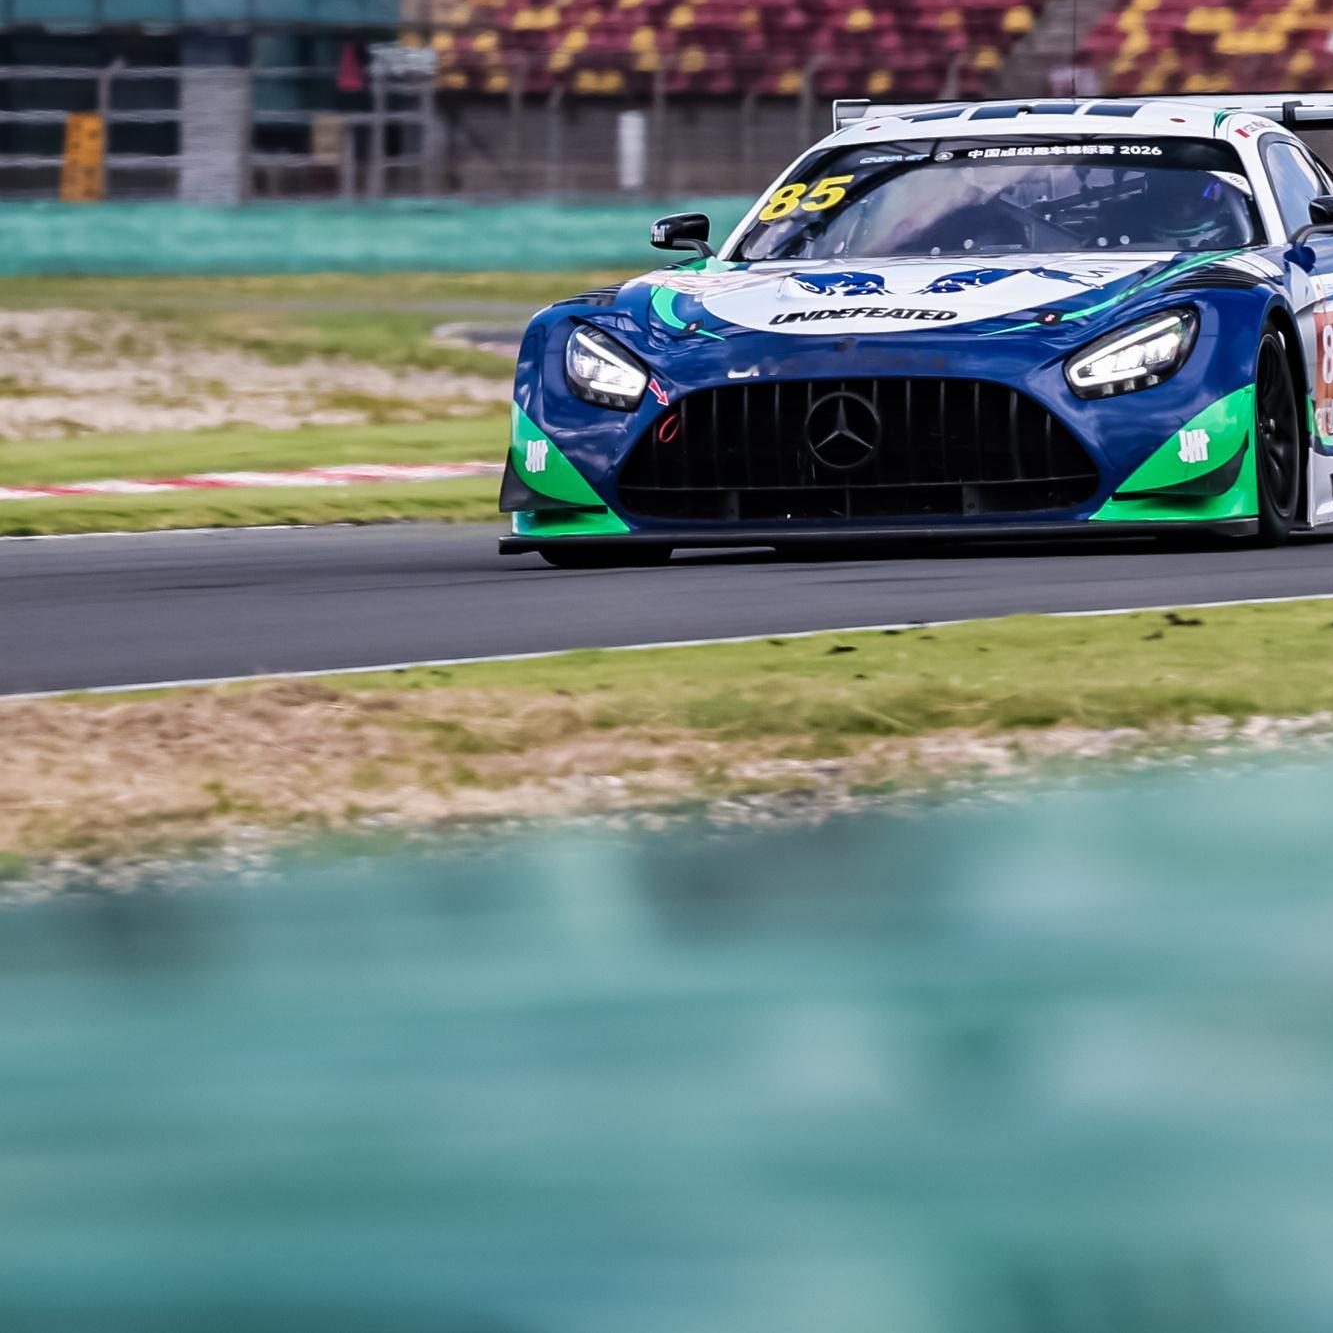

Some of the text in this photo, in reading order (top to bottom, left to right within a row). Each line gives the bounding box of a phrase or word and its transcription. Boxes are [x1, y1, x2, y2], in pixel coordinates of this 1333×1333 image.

[1120, 145, 1162, 156] 2026
[758, 174, 855, 222] 85
[768, 306, 959, 326] UNDEFEATED
